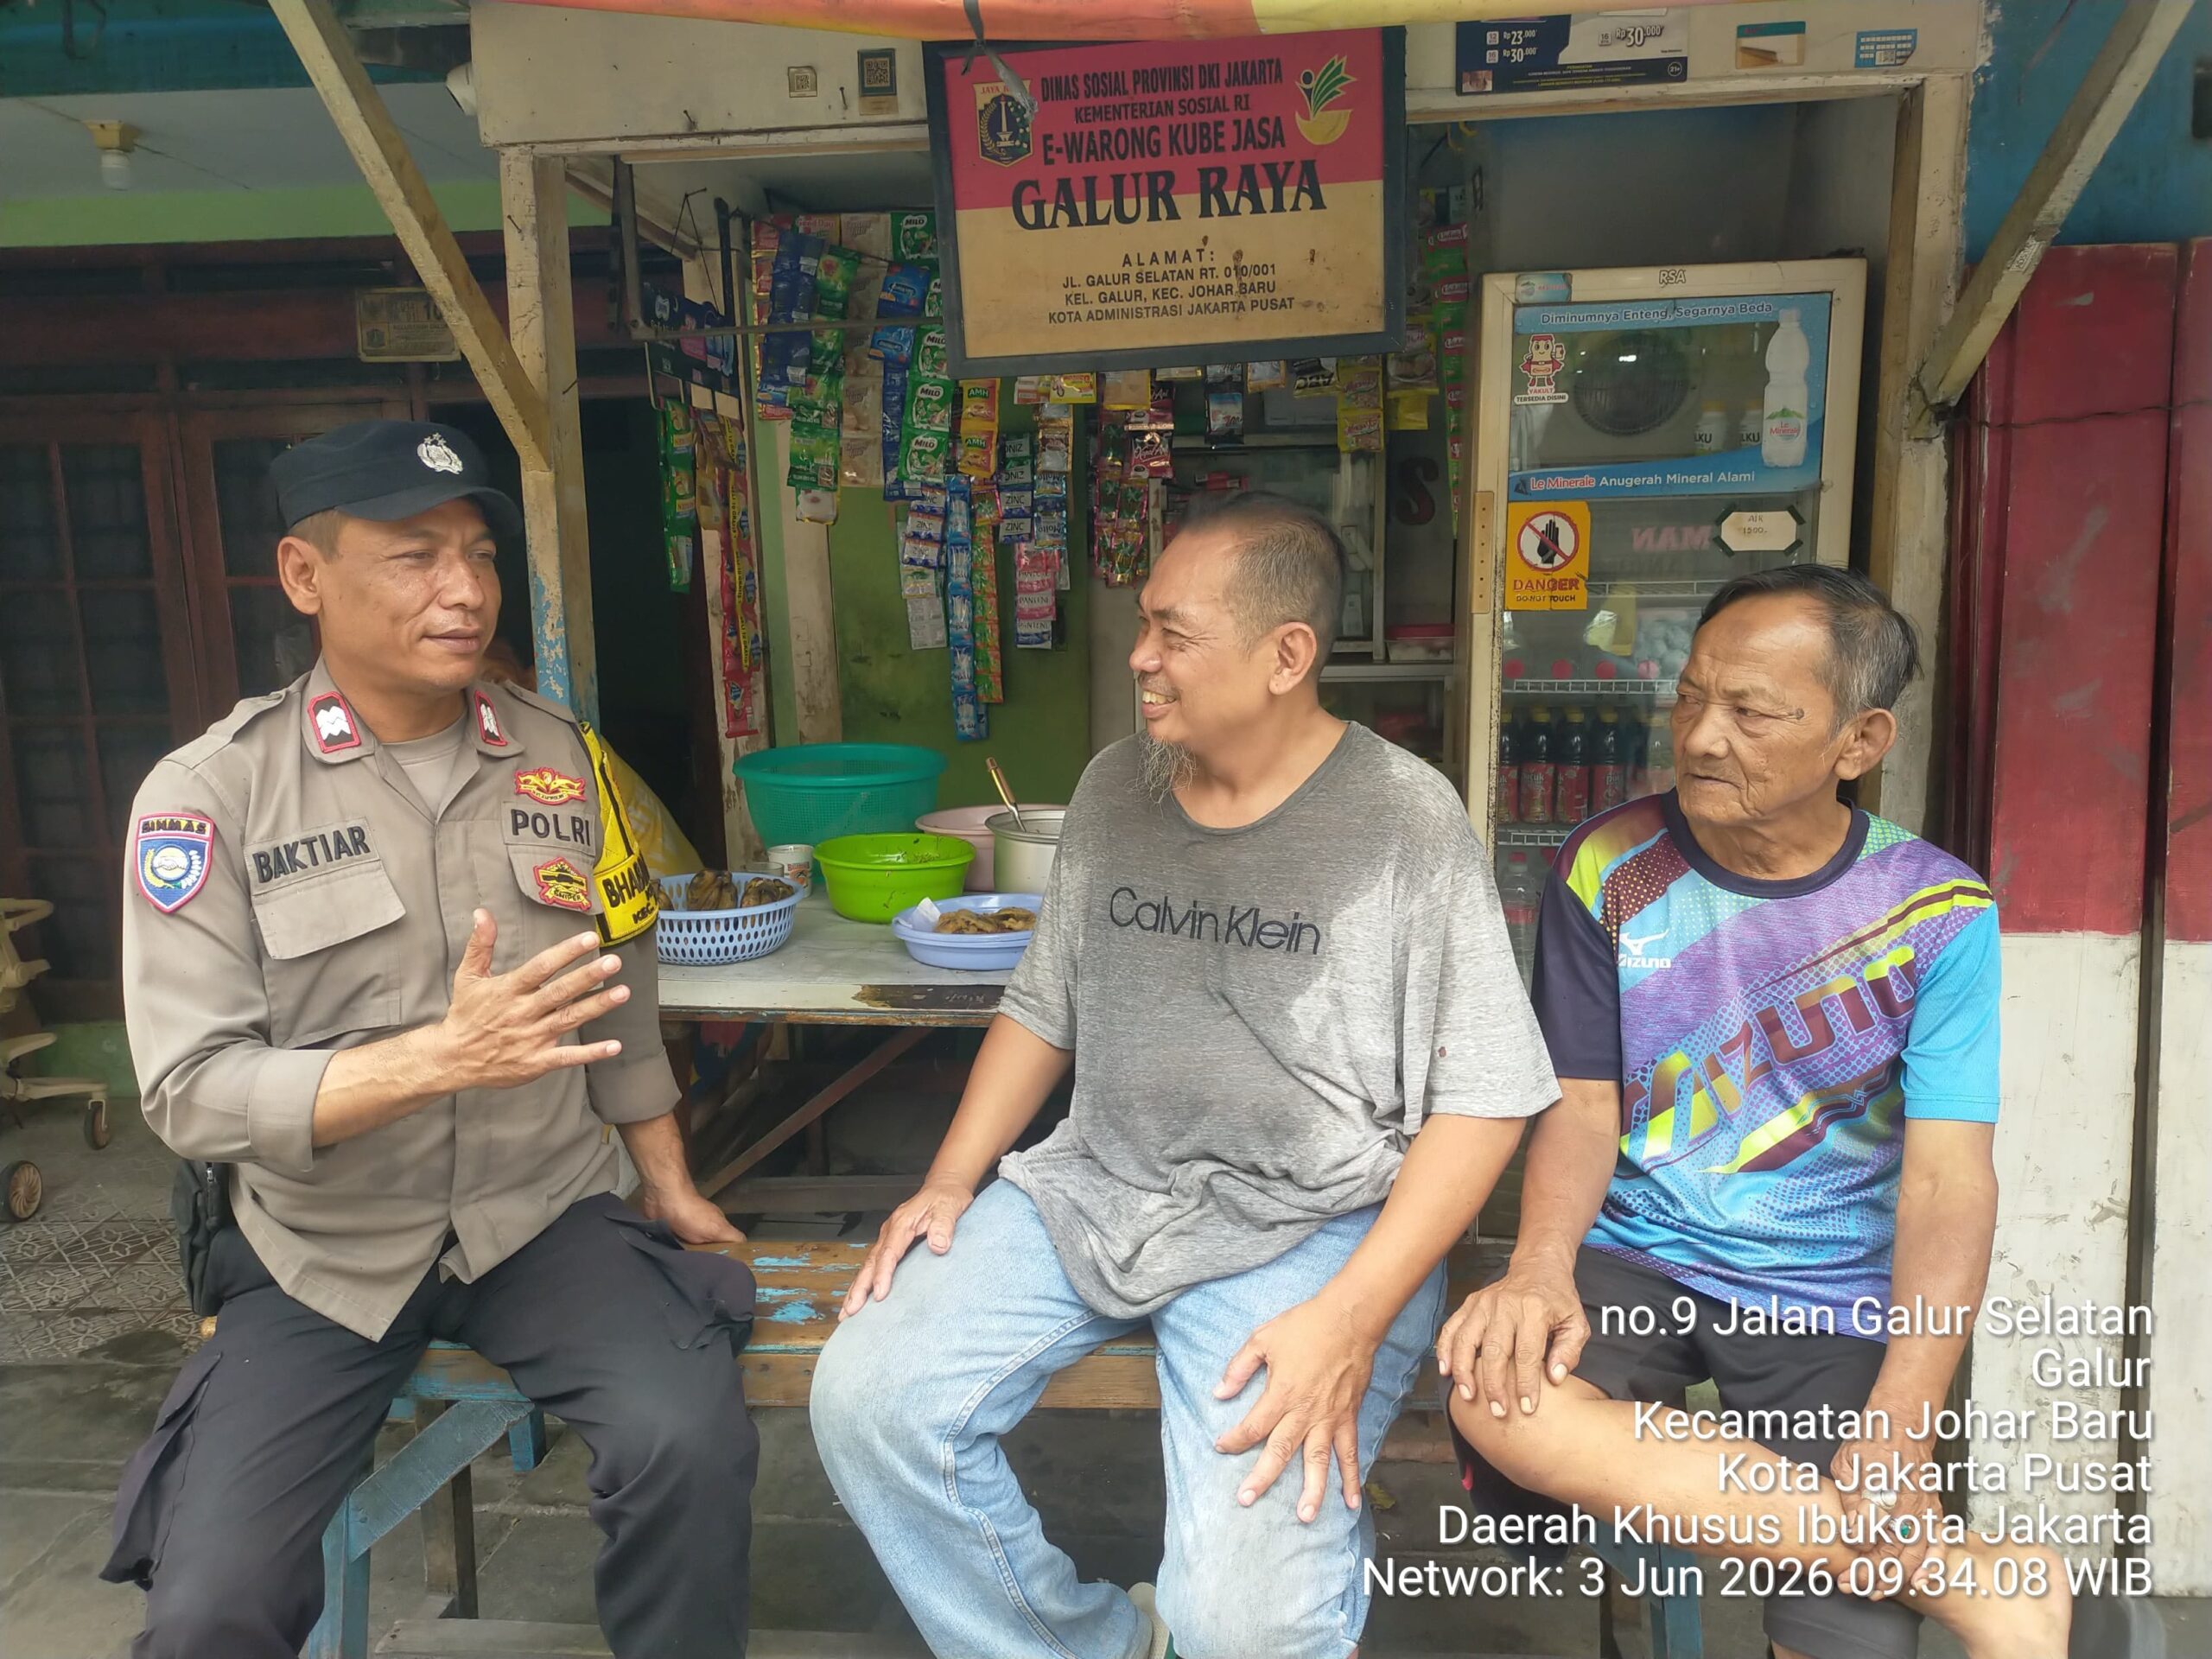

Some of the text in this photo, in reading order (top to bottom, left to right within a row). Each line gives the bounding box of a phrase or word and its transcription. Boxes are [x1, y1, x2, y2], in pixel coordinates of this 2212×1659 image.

[1041, 58, 1283, 102] DINAS SOSIAL PROVINSI DKI JAKARTA
[1074, 94, 1249, 124] KEMENTERIAN SOSIAL RI
[1042, 117, 1285, 166] E-WARONG KUBE JASA
[1011, 159, 1326, 231] GALUR RAYA
[904, 216, 925, 227] MILO
[1063, 264, 1275, 289] JL. GALUR SELATAN RT. 010/001
[1658, 269, 1686, 285] RSA
[1065, 280, 1275, 306] KEL. GALUR, KEC. JOHAR BARU
[1049, 297, 1294, 324] KOTA ADMINISTRASI JAKARTA PUSAT
[1541, 302, 1772, 325] Diminumnya Enteng, Segarnya Beda
[919, 386, 941, 397] MILO
[969, 388, 989, 398] AMH
[914, 438, 936, 449] MILO
[964, 438, 986, 448] AMH
[1530, 470, 1755, 490] Le Minerale Anugerah Mineral Alami
[1005, 495, 1026, 505] ZINC
[1005, 521, 1025, 531] ZINC
[1514, 578, 1580, 591] DANGER
[141, 819, 207, 835] BINMAS
[511, 809, 591, 847] POLRI
[252, 825, 371, 885] BAKTIAR
[1110, 887, 1320, 955] Calvin Klein
